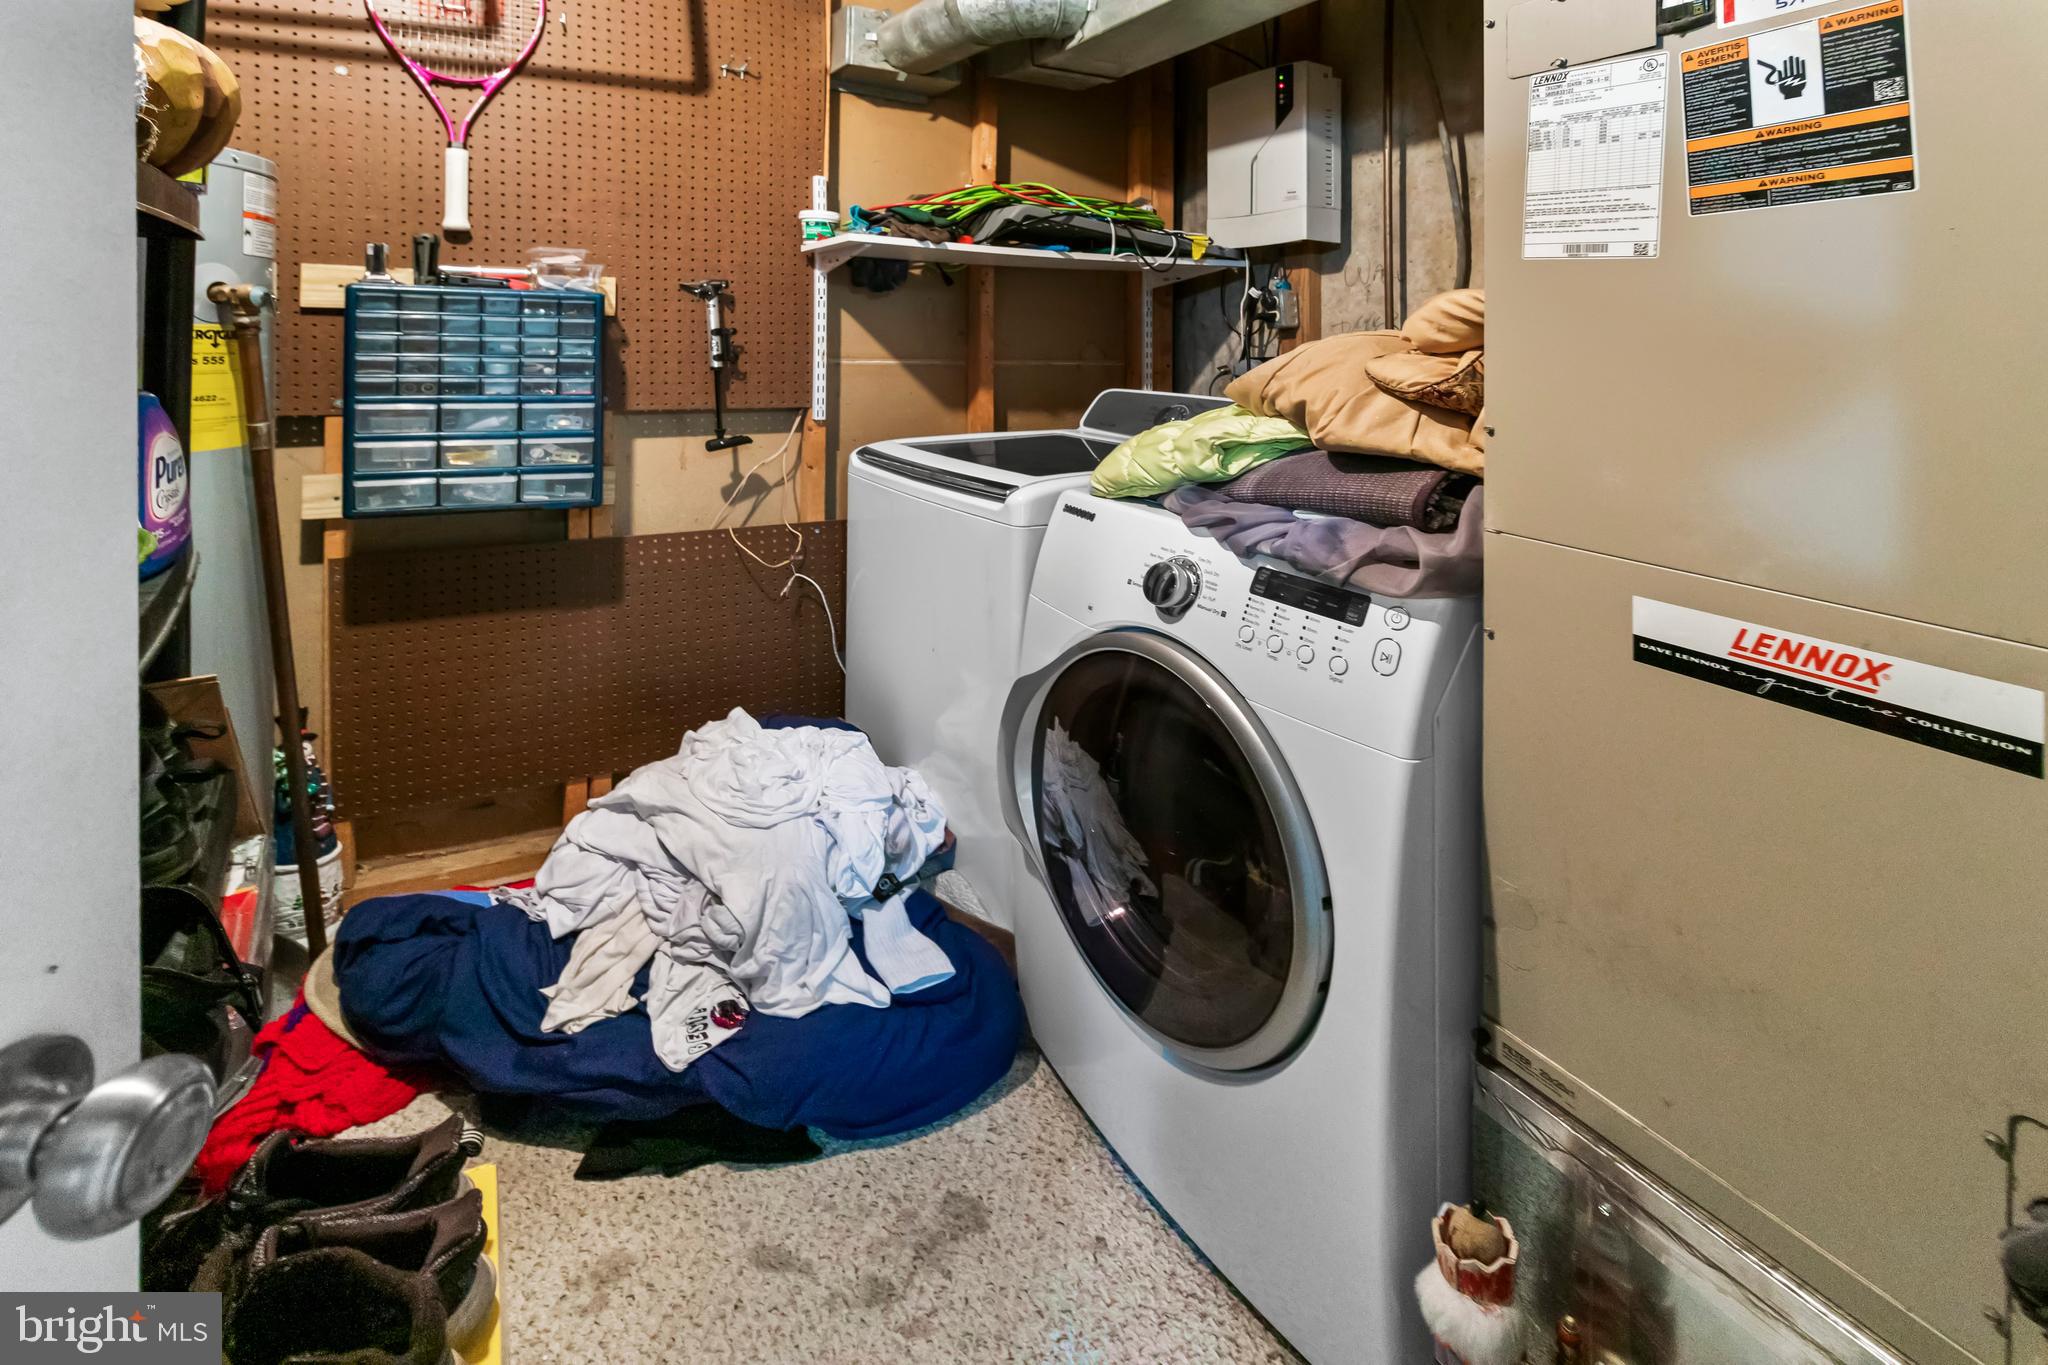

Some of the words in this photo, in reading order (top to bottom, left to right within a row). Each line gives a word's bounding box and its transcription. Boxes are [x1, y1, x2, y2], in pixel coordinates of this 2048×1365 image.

[1835, 5, 1900, 26] WARNING
[1696, 42, 1746, 58] AVERTIS-
[1697, 51, 1742, 67] SEMENT
[1533, 71, 1570, 86] LENNOX
[1765, 121, 1822, 137] WARNING
[1768, 172, 1826, 187] WARNING
[202, 355, 225, 366] 555
[1731, 628, 1894, 687] LENNOX
[1639, 642, 1673, 656] DAVE
[1675, 652, 1731, 672] LENNOX
[1904, 716, 2033, 756] COLLECTION
